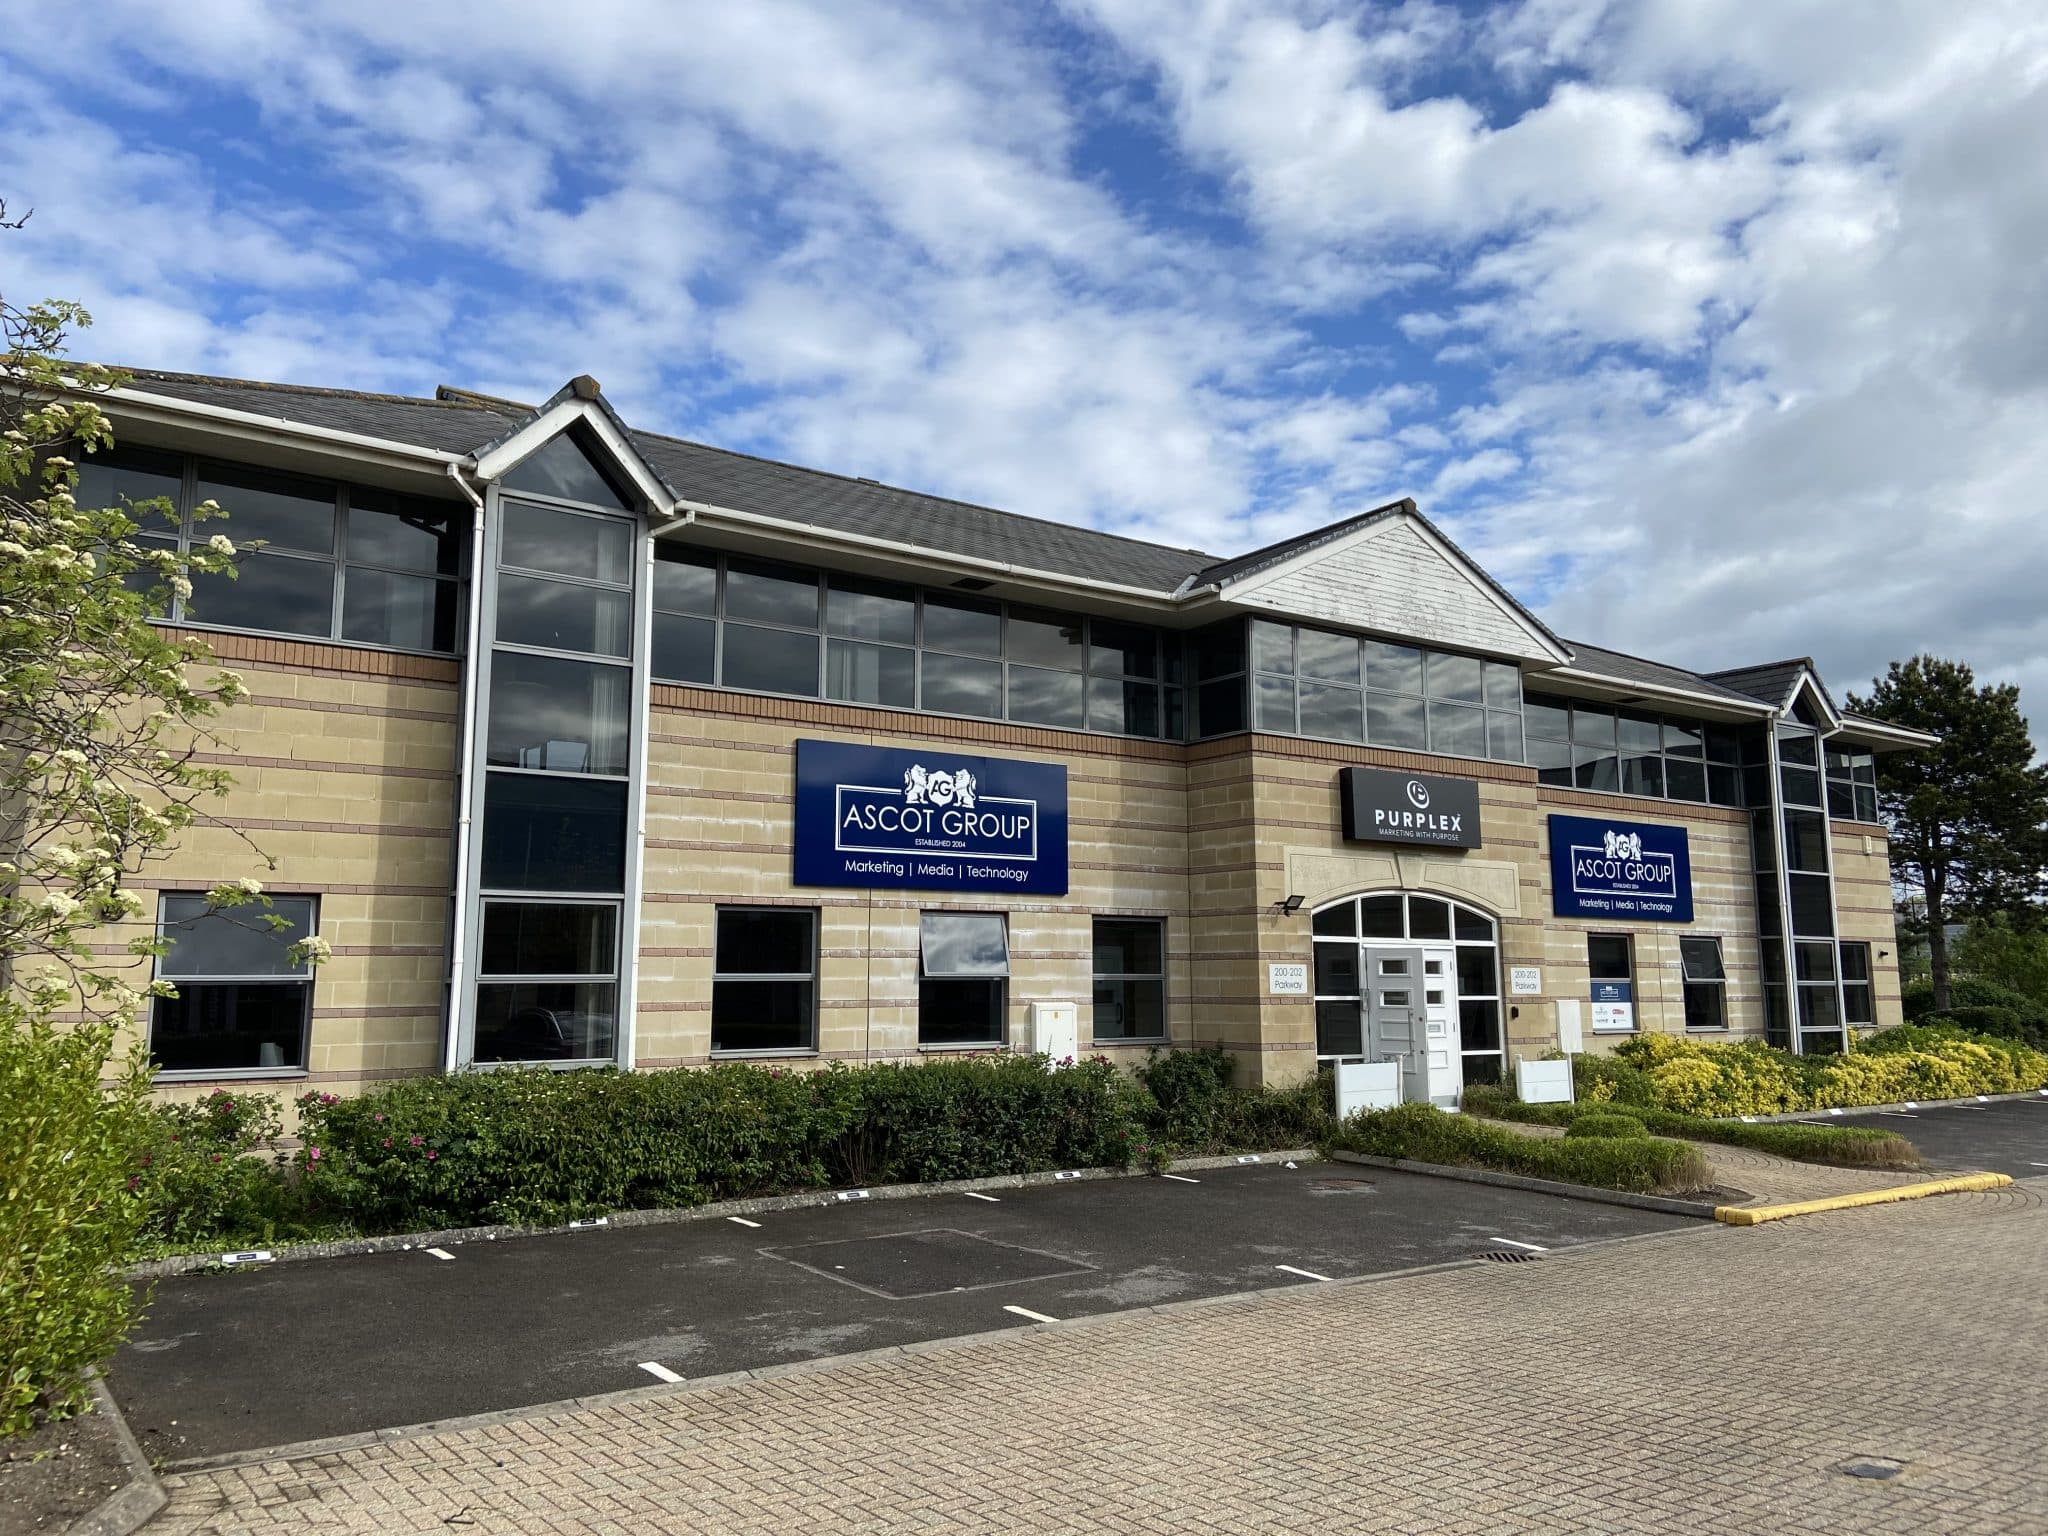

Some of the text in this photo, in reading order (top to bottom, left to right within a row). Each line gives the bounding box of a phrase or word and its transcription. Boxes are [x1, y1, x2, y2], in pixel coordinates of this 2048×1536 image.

[931, 780, 952, 797] AG
[843, 804, 1030, 839] ASCOT GROUP
[1375, 809, 1462, 832] PURPLEX
[1379, 828, 1460, 841] MARKETING WITH PURPOSE
[915, 839, 966, 848] ESTABLISHED 2004
[845, 860, 1029, 882] Marketing Media Technology
[1577, 859, 1671, 882] ASCOT GROUP
[1580, 899, 1673, 913] Marketing Media Technology
[1274, 980, 1303, 991] Parkway
